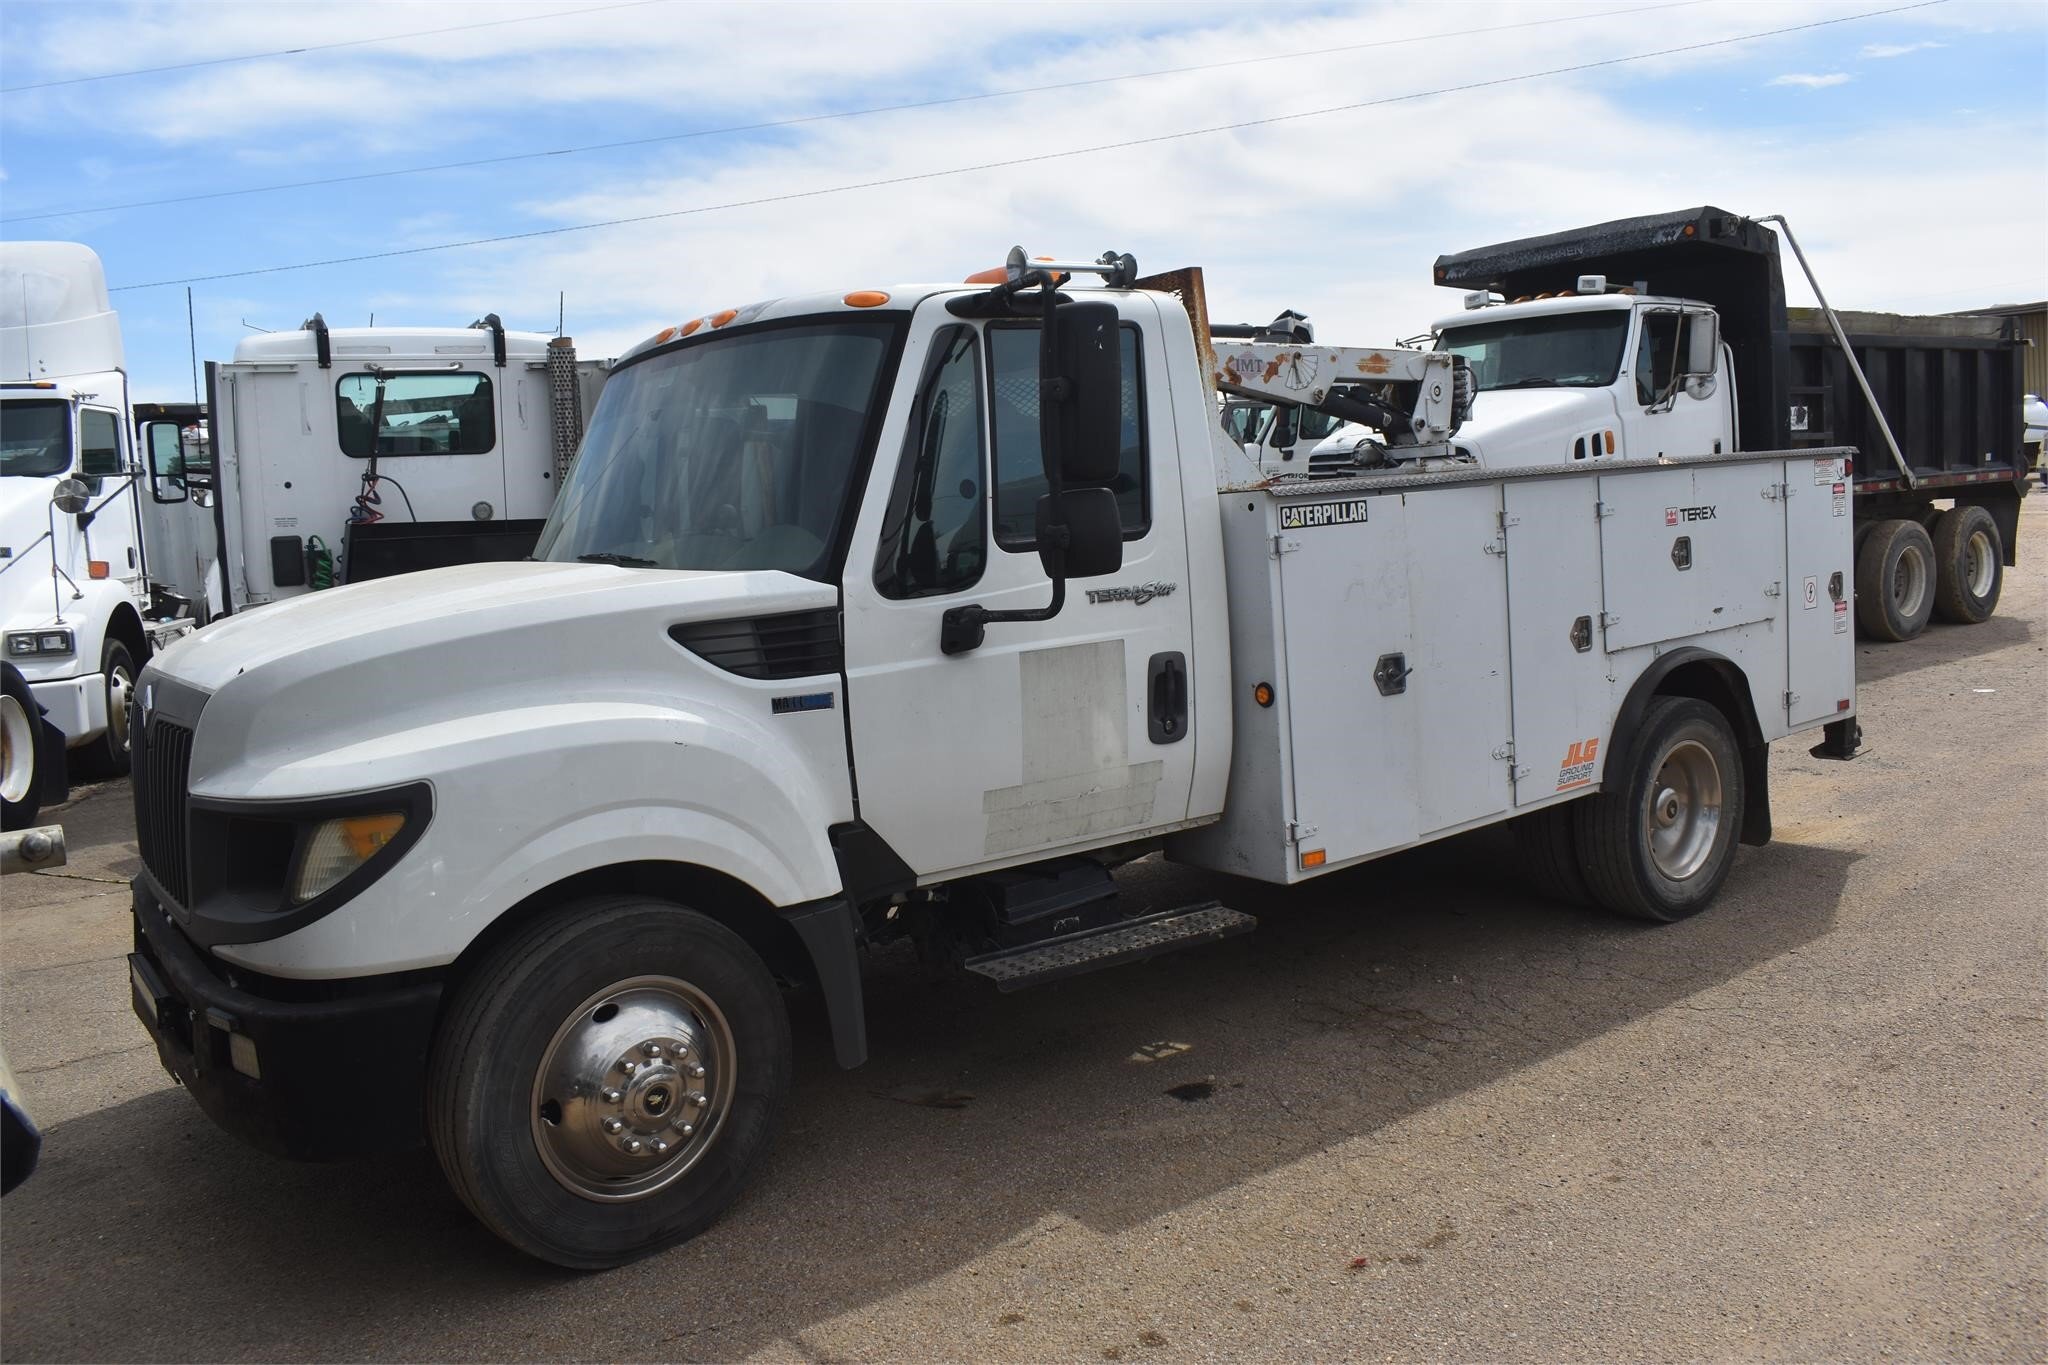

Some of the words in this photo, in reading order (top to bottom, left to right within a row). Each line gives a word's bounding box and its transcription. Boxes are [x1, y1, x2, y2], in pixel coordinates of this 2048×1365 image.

[1236, 359, 1262, 372] IMT
[1281, 502, 1366, 528] CATERPILLAR
[1680, 505, 1716, 522] TEREX
[1562, 738, 1599, 768] JLG
[1560, 762, 1594, 777] GROUND
[1557, 771, 1592, 785] SUPPORT
